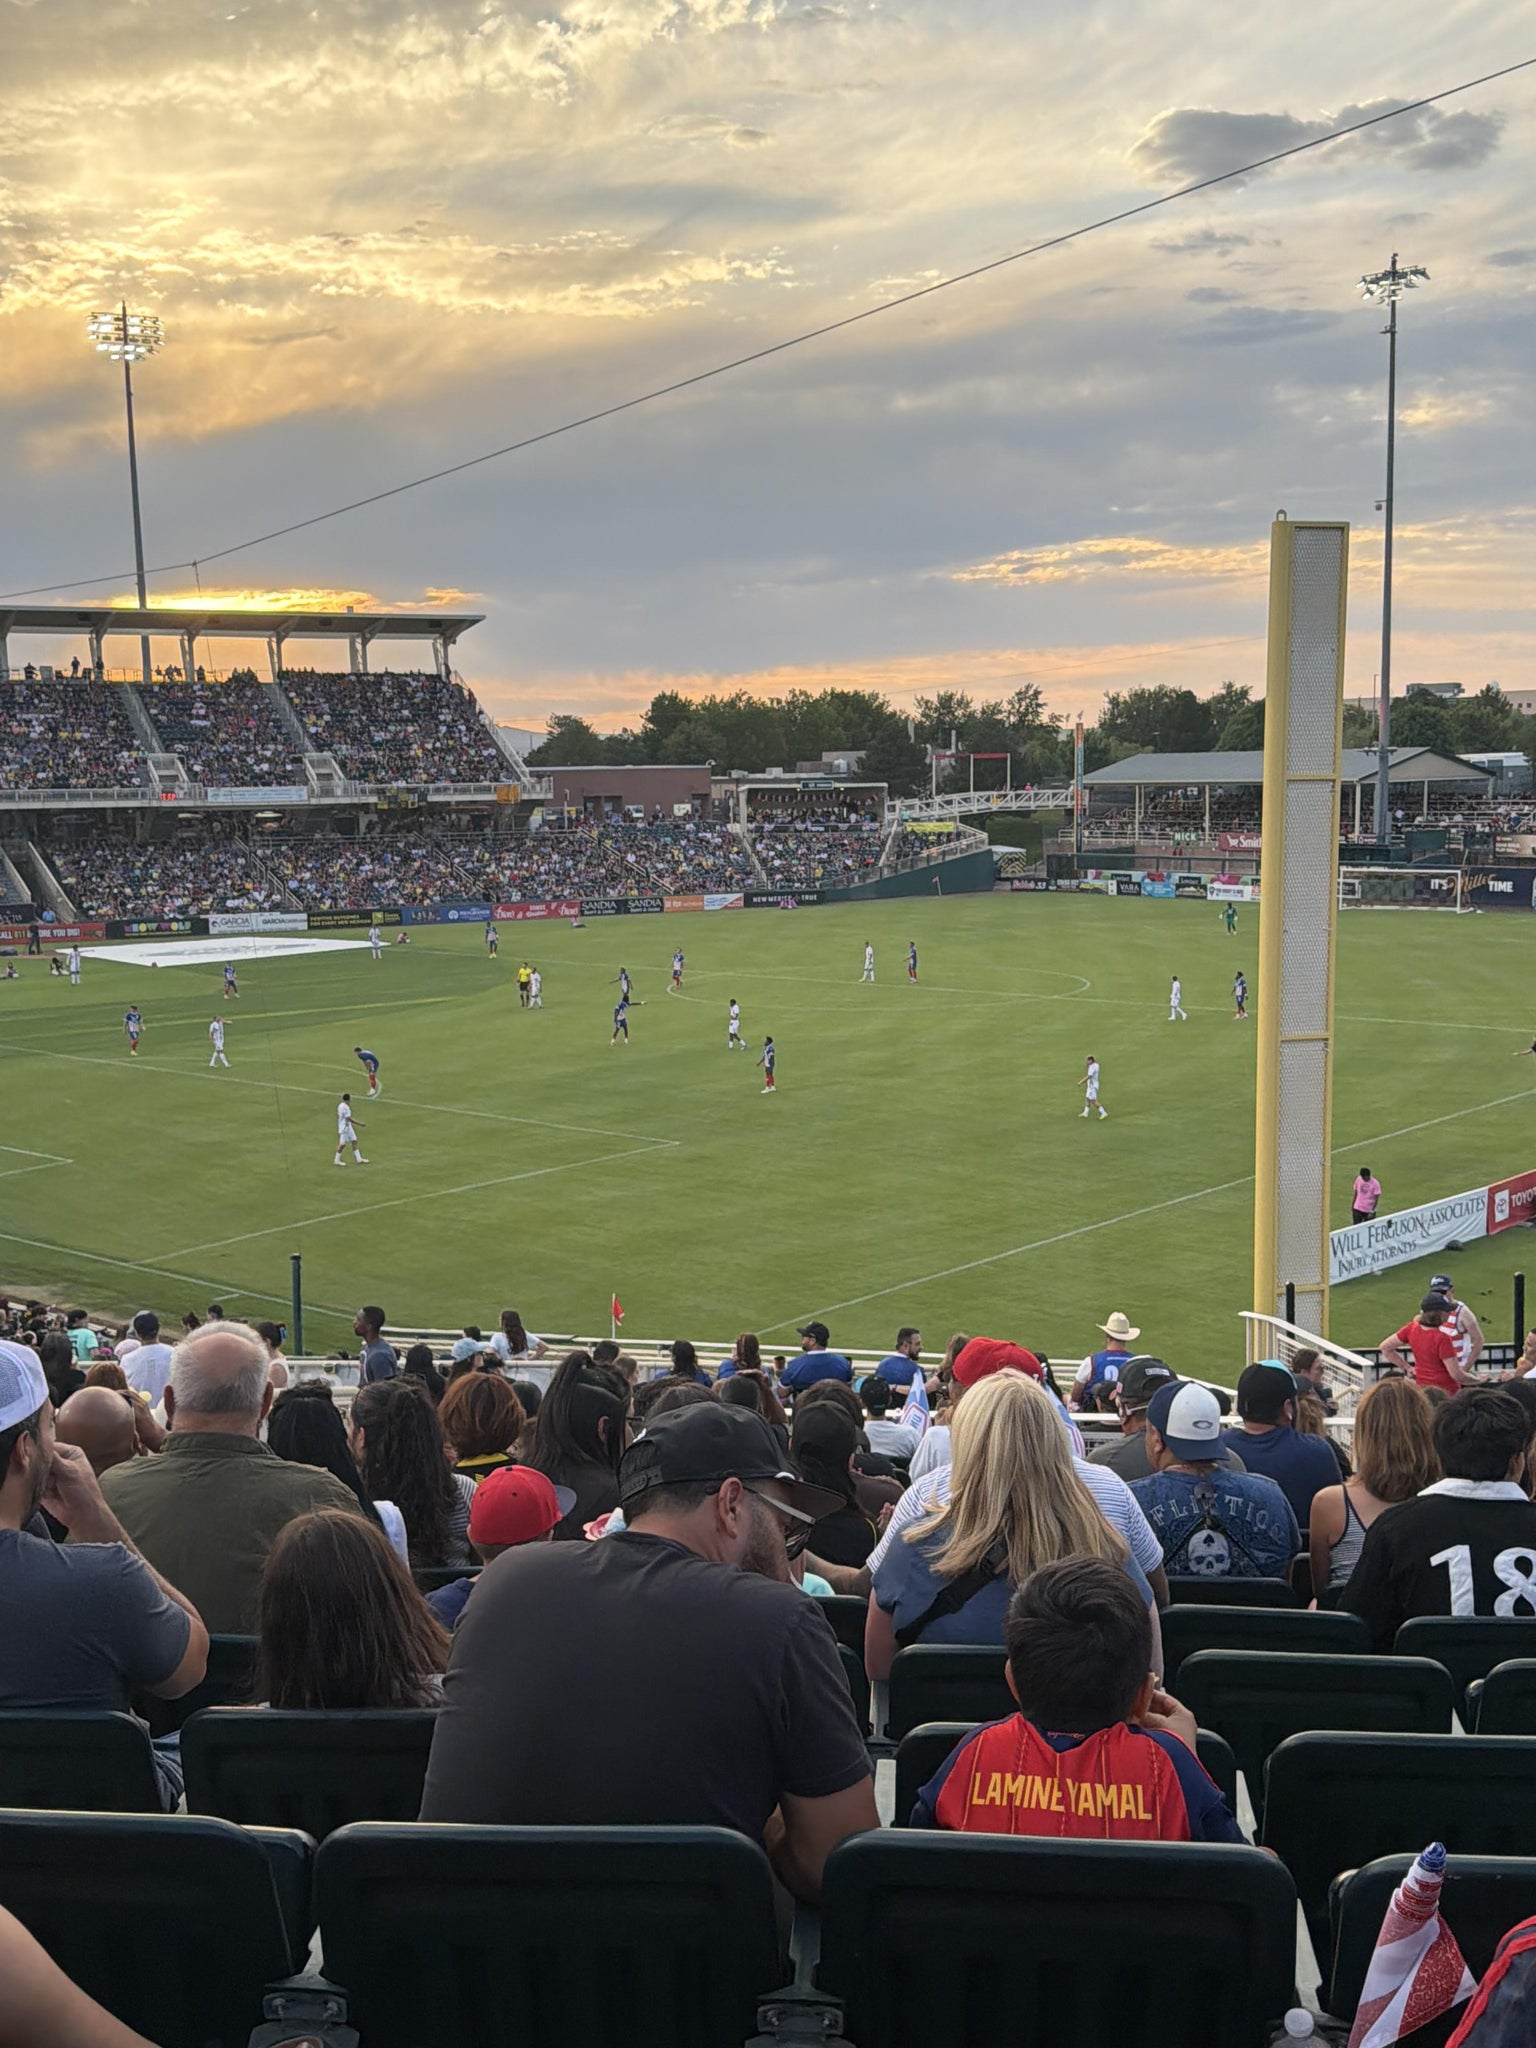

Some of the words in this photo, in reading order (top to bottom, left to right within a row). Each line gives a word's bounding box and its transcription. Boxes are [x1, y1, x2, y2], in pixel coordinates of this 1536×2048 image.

[1120, 884, 1140, 892] VARA
[1431, 879, 1449, 890] IT'S
[1489, 881, 1514, 893] TIME
[582, 901, 617, 910] SANDIA
[627, 899, 662, 908] SANDIA
[220, 917, 250, 926] GARCIA
[1430, 1544, 1536, 1617] 18
[971, 1772, 1065, 1812] LAMINE
[1065, 1778, 1152, 1820] YAMAL
